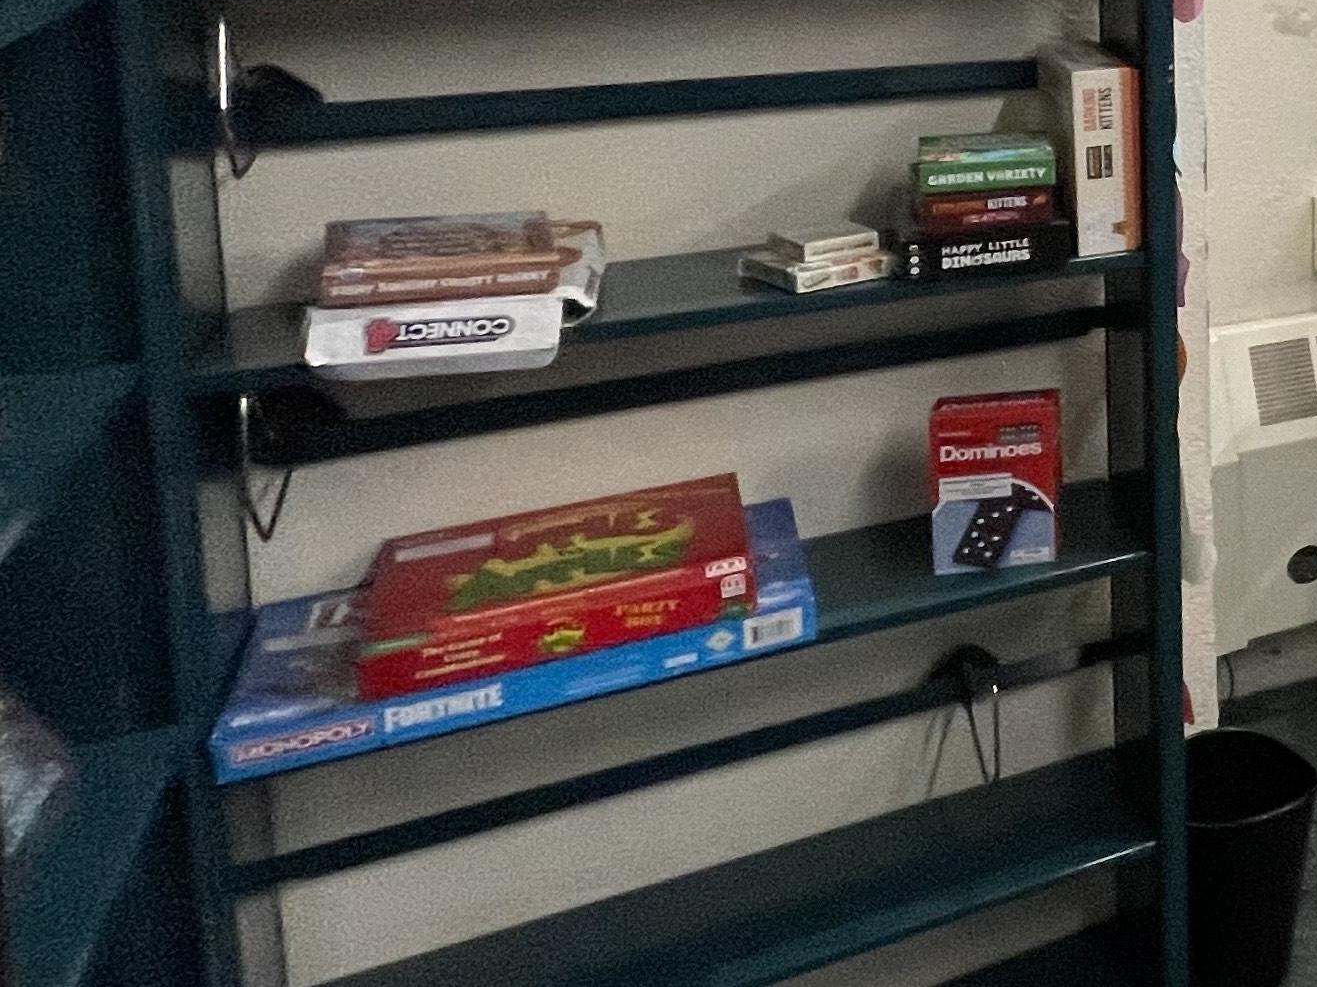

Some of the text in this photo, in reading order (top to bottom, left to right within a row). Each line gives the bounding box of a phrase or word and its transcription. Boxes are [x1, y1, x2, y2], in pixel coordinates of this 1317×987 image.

[1098, 87, 1112, 130] KITTENS
[927, 167, 1047, 186] GARDEN VARIETY
[941, 237, 1030, 257] HAPPY LITTLE
[941, 249, 1031, 270] DINOSAURS
[396, 318, 511, 342] CONNECT
[939, 442, 1043, 463] Dominoes
[615, 599, 680, 616] PARTY
[231, 718, 372, 764] MONOPOLY
